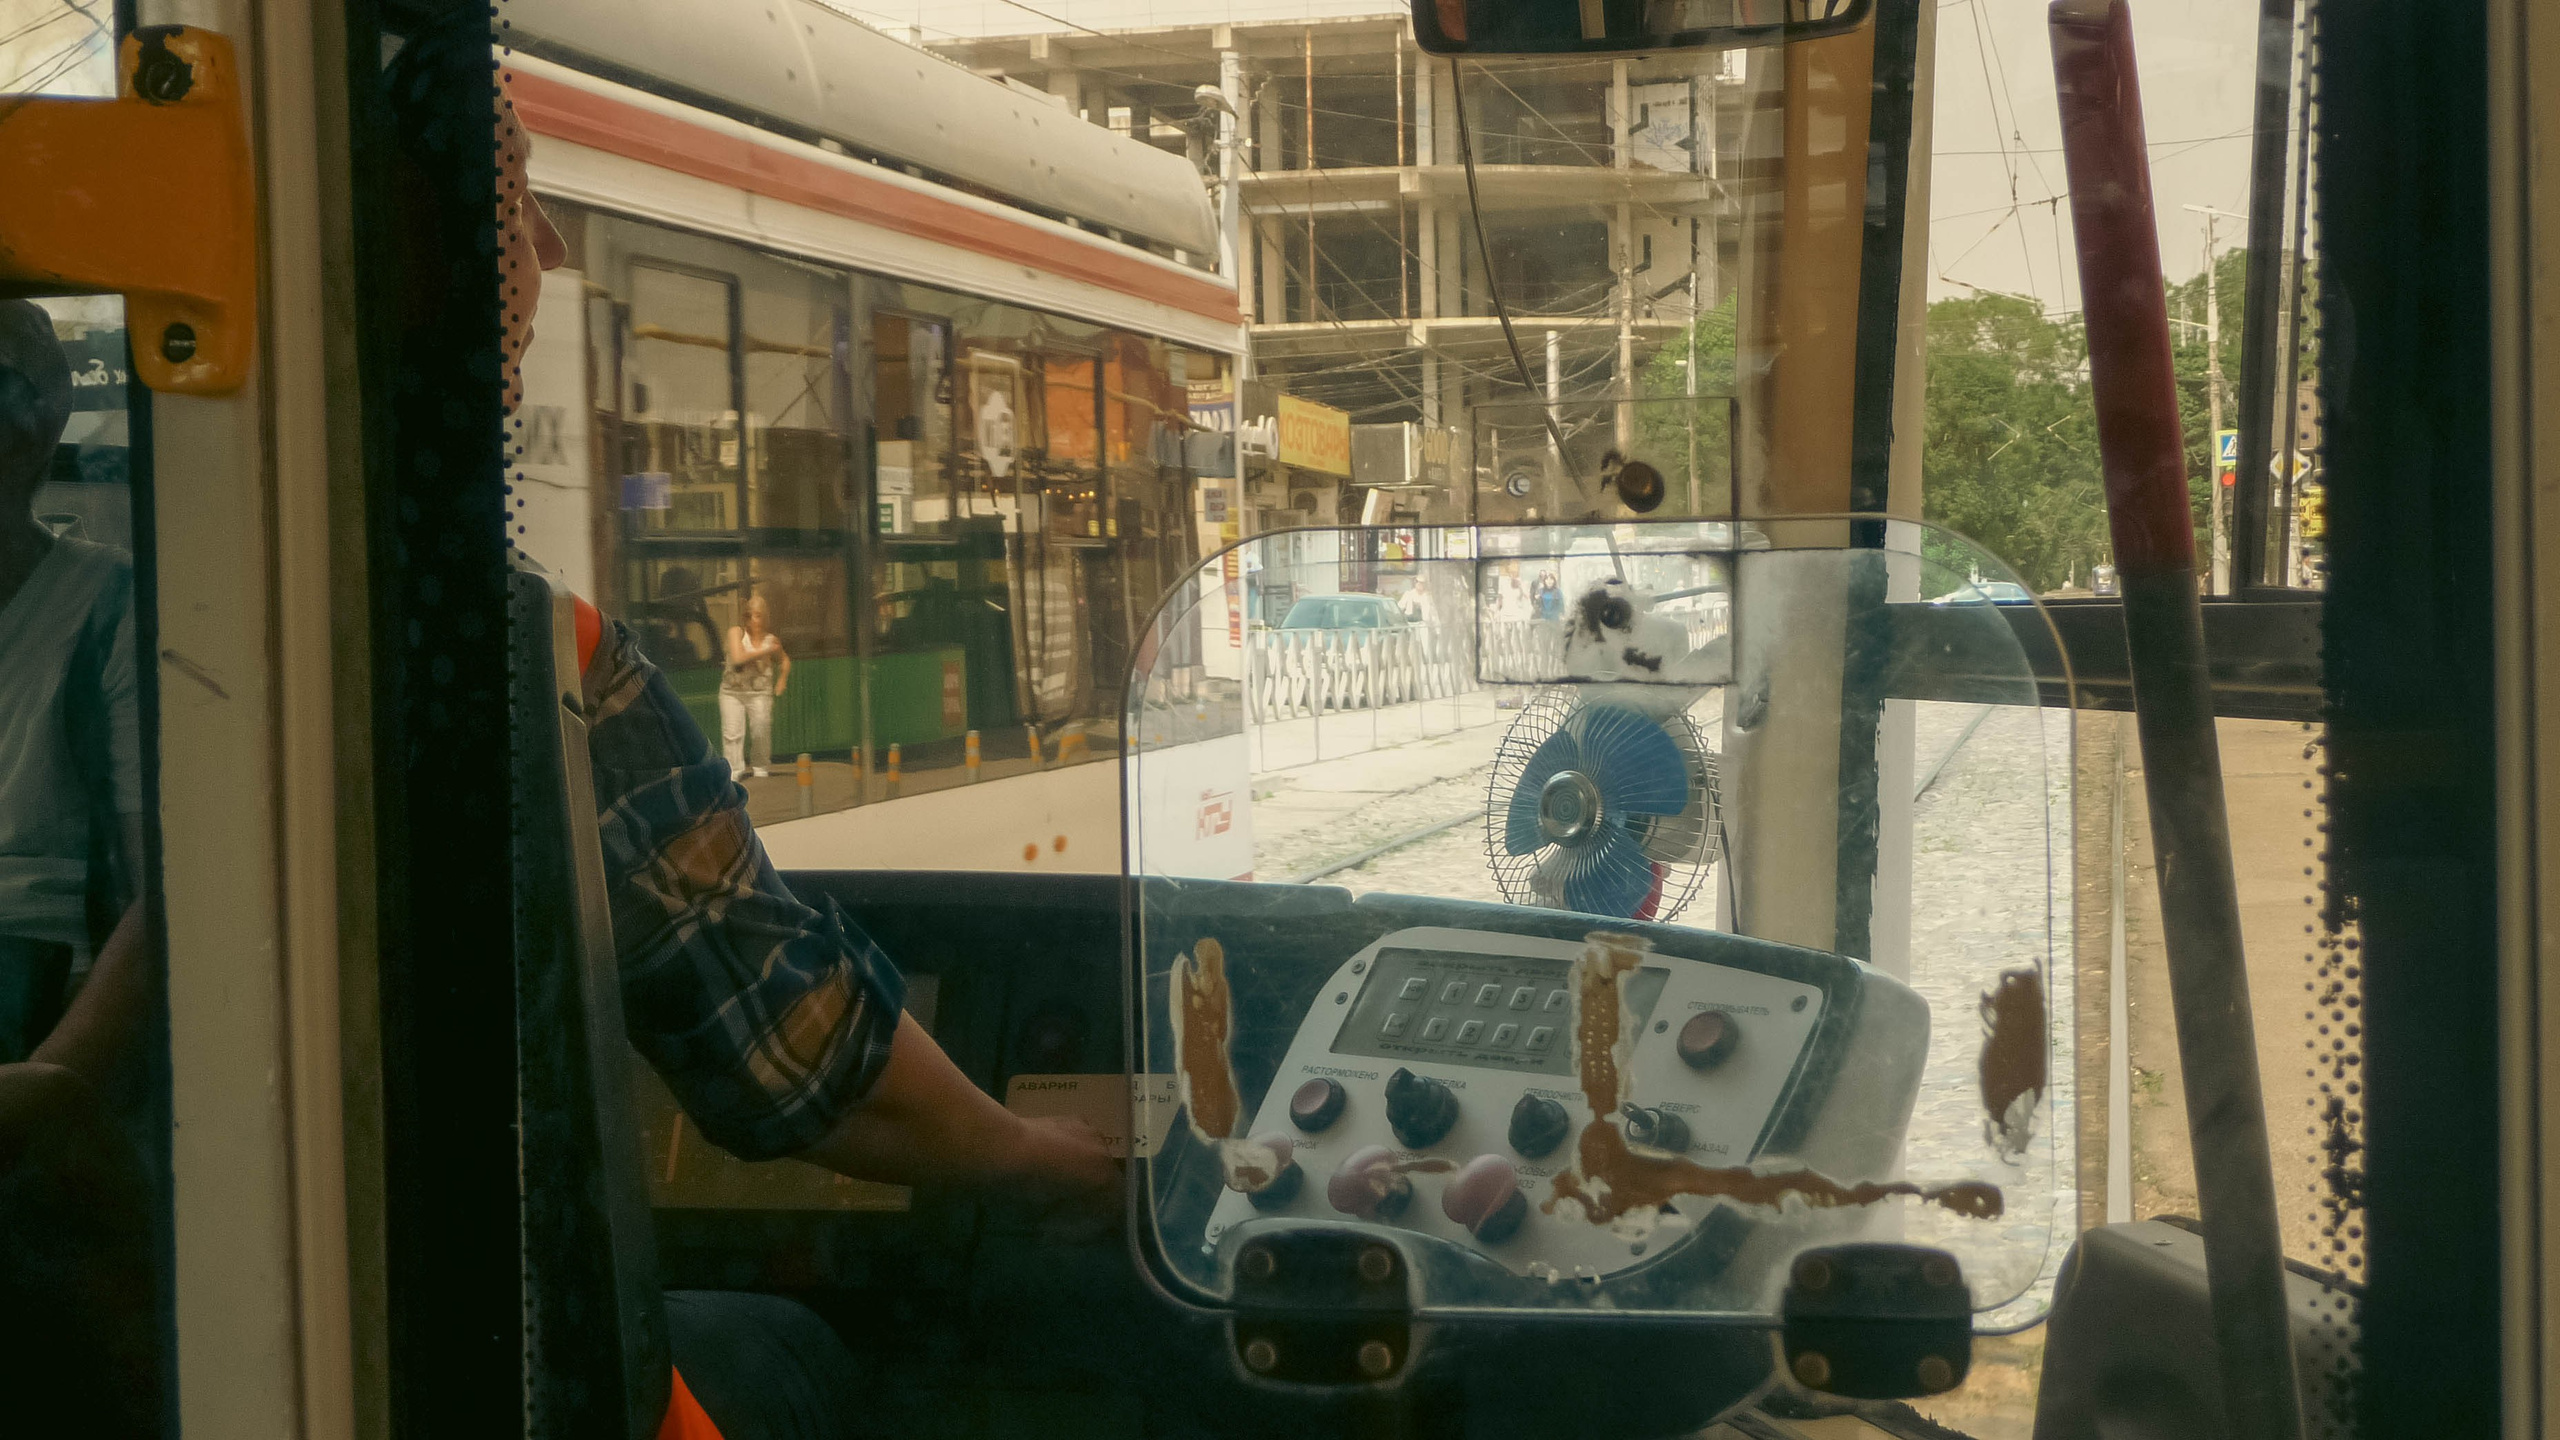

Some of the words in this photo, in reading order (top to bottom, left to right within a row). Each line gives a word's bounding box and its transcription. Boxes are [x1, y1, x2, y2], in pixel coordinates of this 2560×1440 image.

[1482, 991, 1494, 1001] 2
[1516, 992, 1527, 1003] 3
[1464, 1026, 1476, 1037] 2
[1301, 1065, 1379, 1081] РАСТОРМОЖЕНО
[1016, 1081, 1079, 1091] АВАРИЯ
[1658, 1101, 1702, 1114] РЕВЕРС
